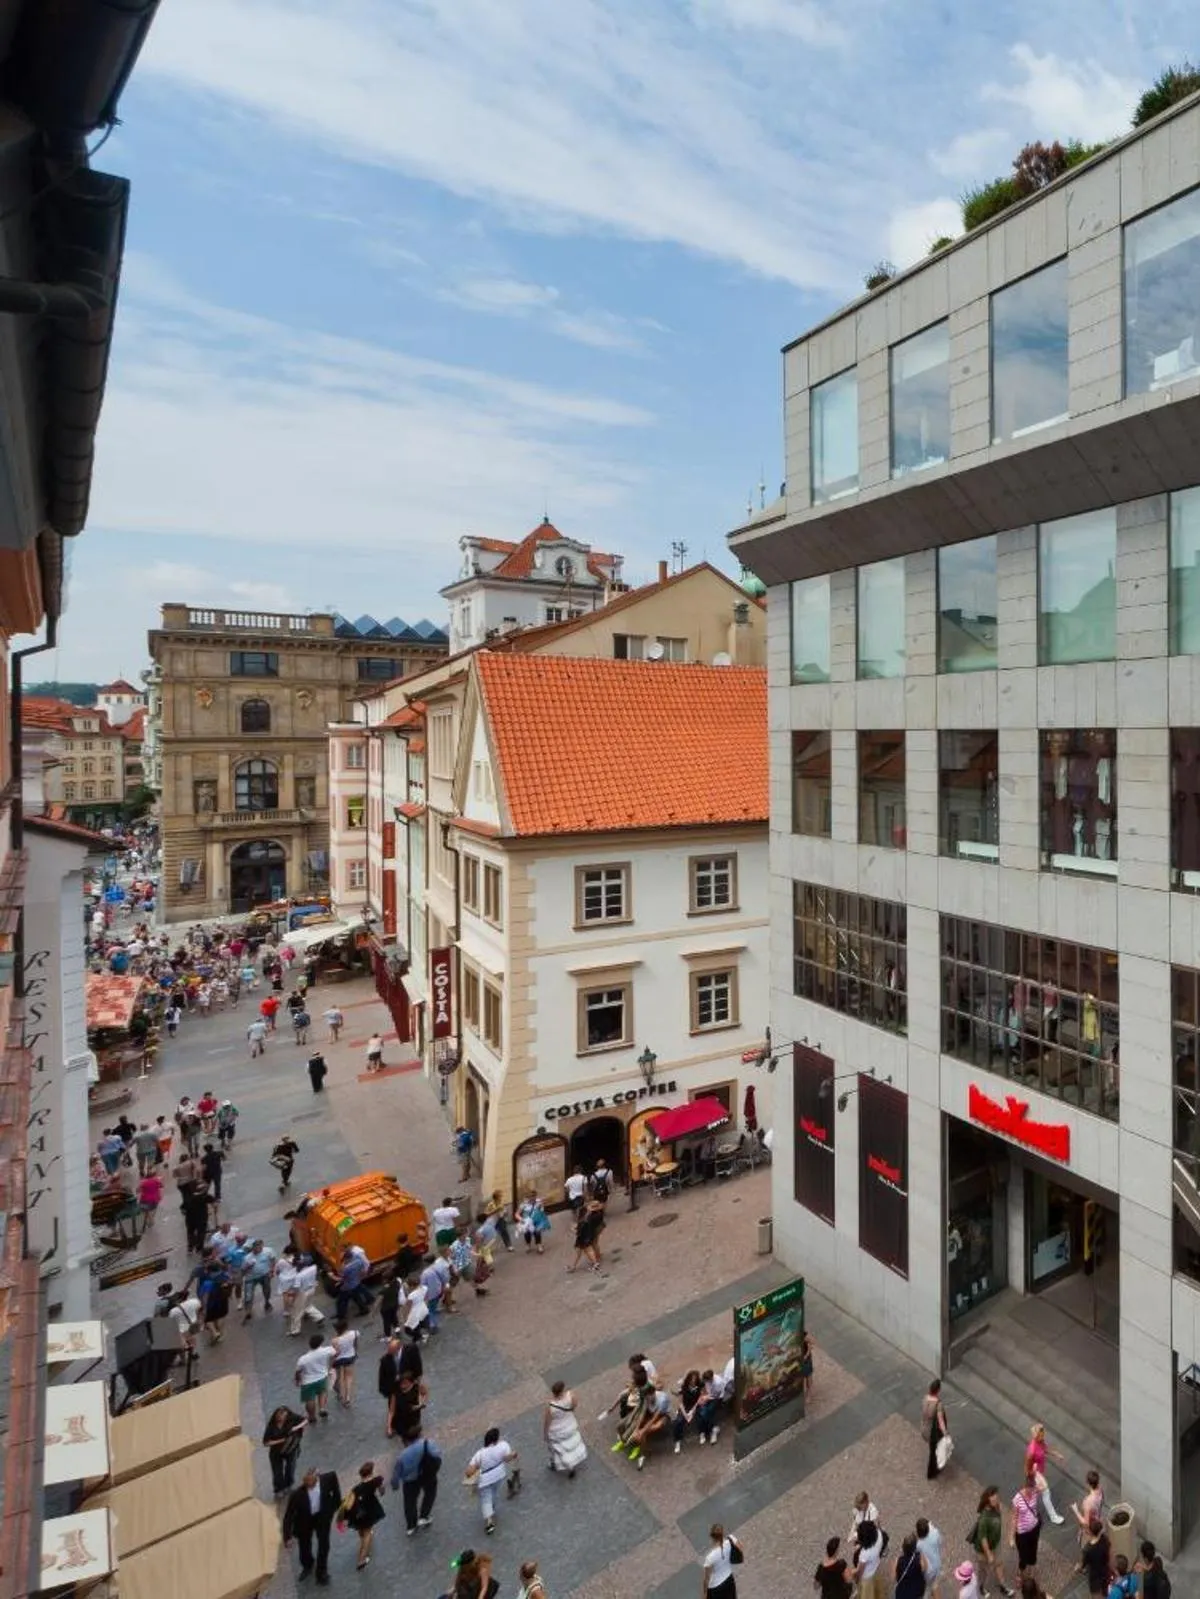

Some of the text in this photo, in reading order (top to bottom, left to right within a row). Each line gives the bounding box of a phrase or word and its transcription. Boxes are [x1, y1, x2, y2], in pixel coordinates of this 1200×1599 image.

[434, 963, 449, 1024] COSTA
[544, 1080, 678, 1120] COSTA COFFEE
